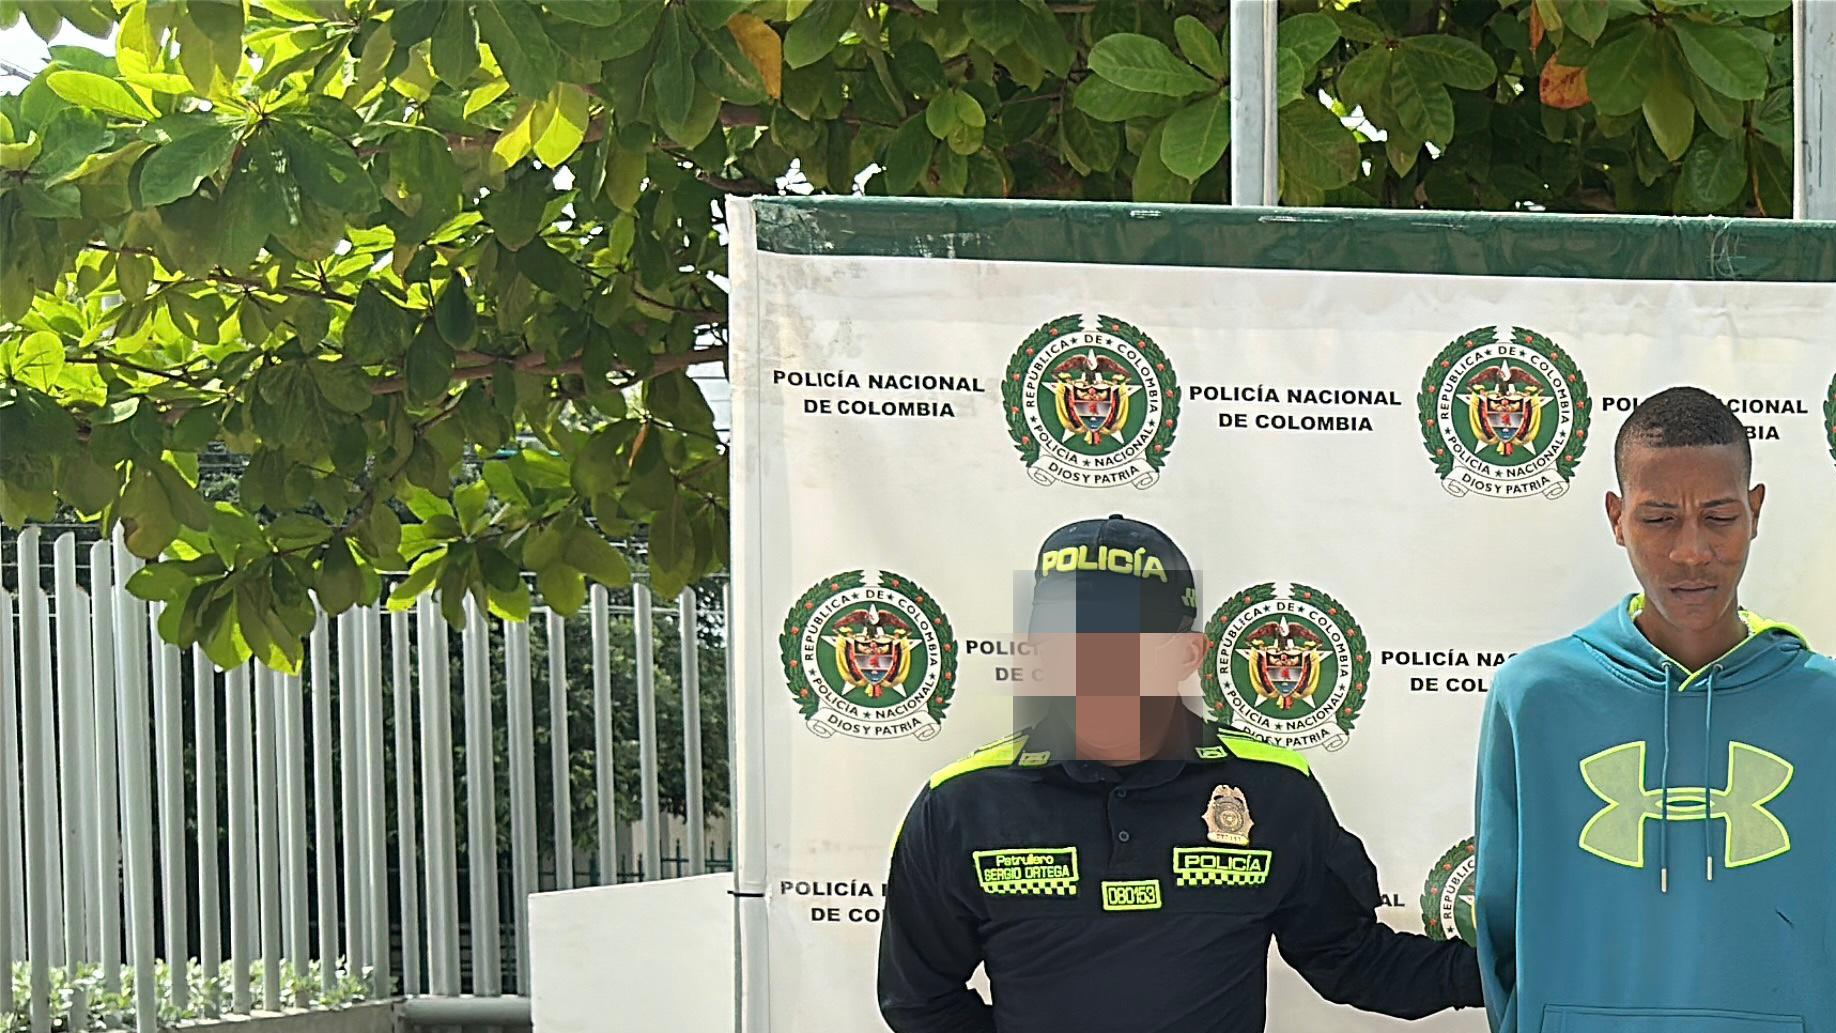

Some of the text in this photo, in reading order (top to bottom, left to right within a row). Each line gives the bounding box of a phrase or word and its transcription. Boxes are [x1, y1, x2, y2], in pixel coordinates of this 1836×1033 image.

[773, 369, 986, 393] POLICÍA NACIONAL
[1083, 333, 1104, 345] DE
[1116, 343, 1161, 413] COLOMBIA
[1189, 384, 1402, 406] POLICÍA NACIONAL
[803, 399, 956, 418] DE COLOMBIA
[1729, 398, 1809, 416] CIONAL
[1218, 413, 1373, 432] DE COLOMBIA
[1094, 428, 1157, 467] NACIONAL
[1048, 460, 1083, 482] DIOS
[1093, 463, 1143, 487] PATRIA
[1042, 545, 1168, 583] POLICÍA
[863, 588, 883, 600] DE
[895, 598, 942, 667] COLOMBIA
[966, 640, 1036, 656] POLIC
[1381, 648, 1470, 667] POLICÍA
[1410, 677, 1438, 692] DE
[874, 681, 937, 719] NACIONAL
[827, 713, 863, 734] DIOS
[873, 715, 923, 739] PATRIA
[1184, 854, 1262, 871] POLICÍA
[984, 865, 1070, 881] SERGIO ORTEGA
[780, 879, 874, 897] POLICÍA
[811, 907, 841, 922] DE
